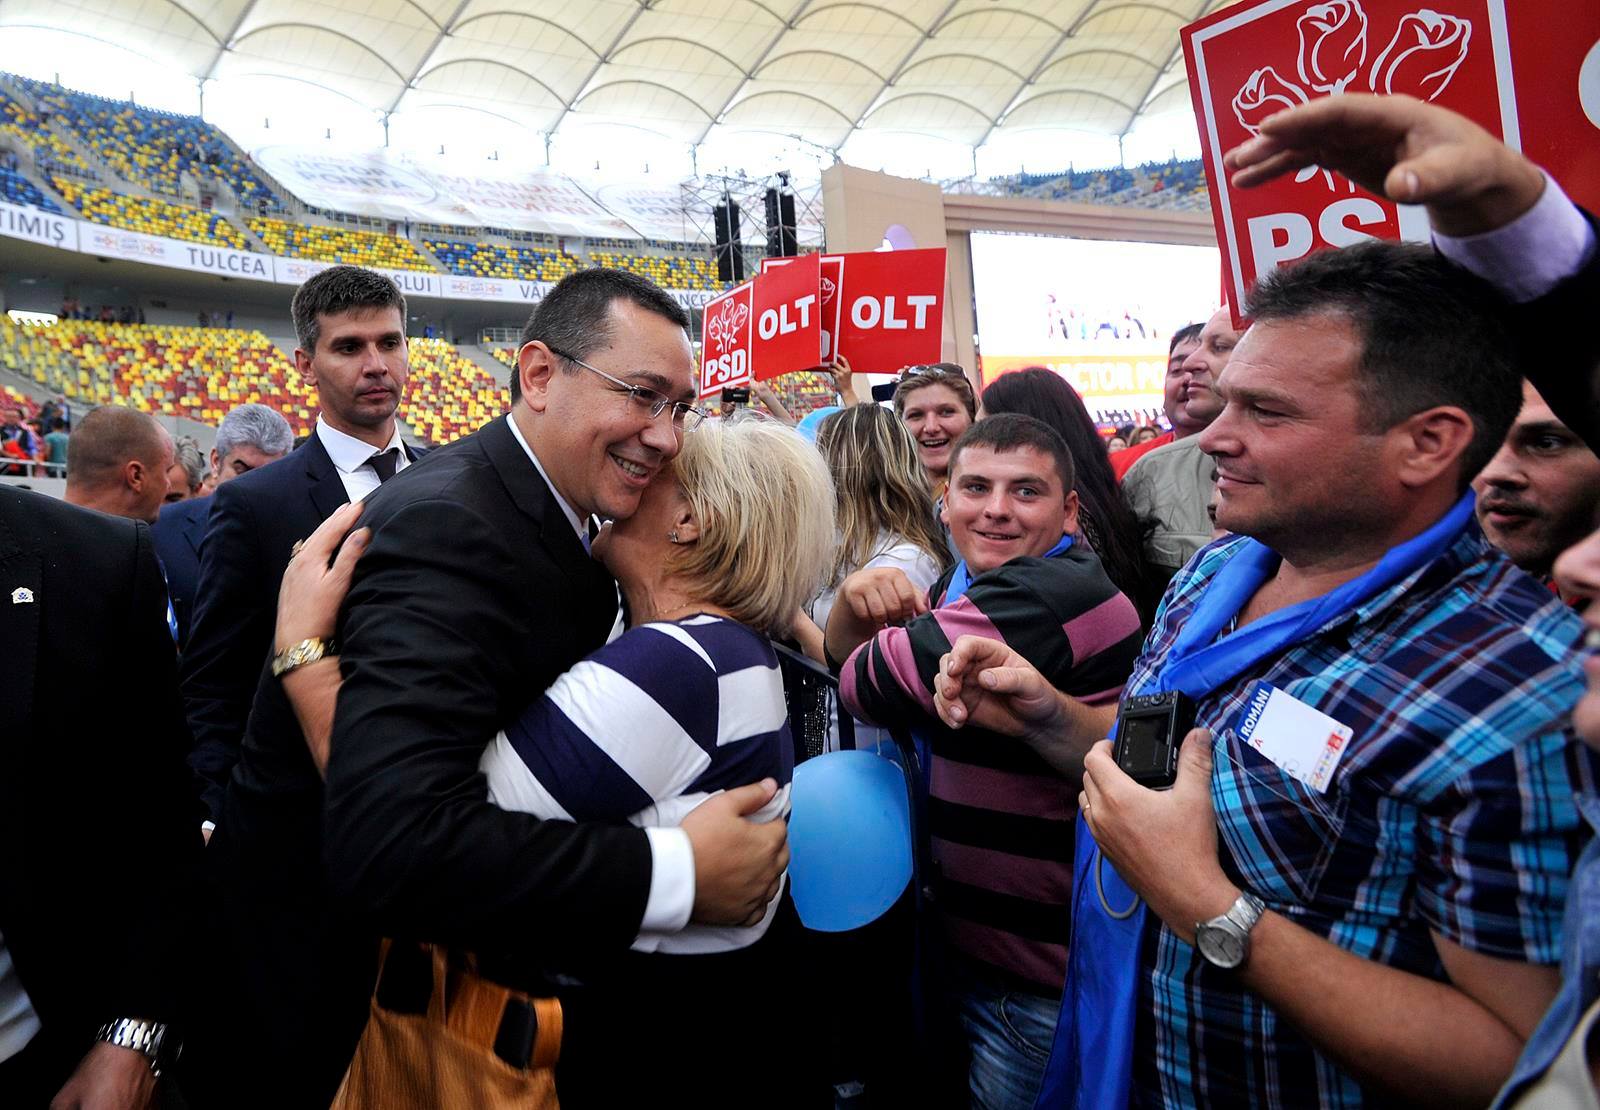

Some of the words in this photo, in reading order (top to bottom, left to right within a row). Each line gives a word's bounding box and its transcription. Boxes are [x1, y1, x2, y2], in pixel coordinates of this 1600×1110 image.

[186, 246, 266, 276] TULCEA
[393, 274, 431, 292] SLUI
[758, 294, 816, 340] OLT
[851, 295, 937, 329] OLT
[705, 349, 747, 387] PSD
[1240, 688, 1270, 738] ROMÂNI
